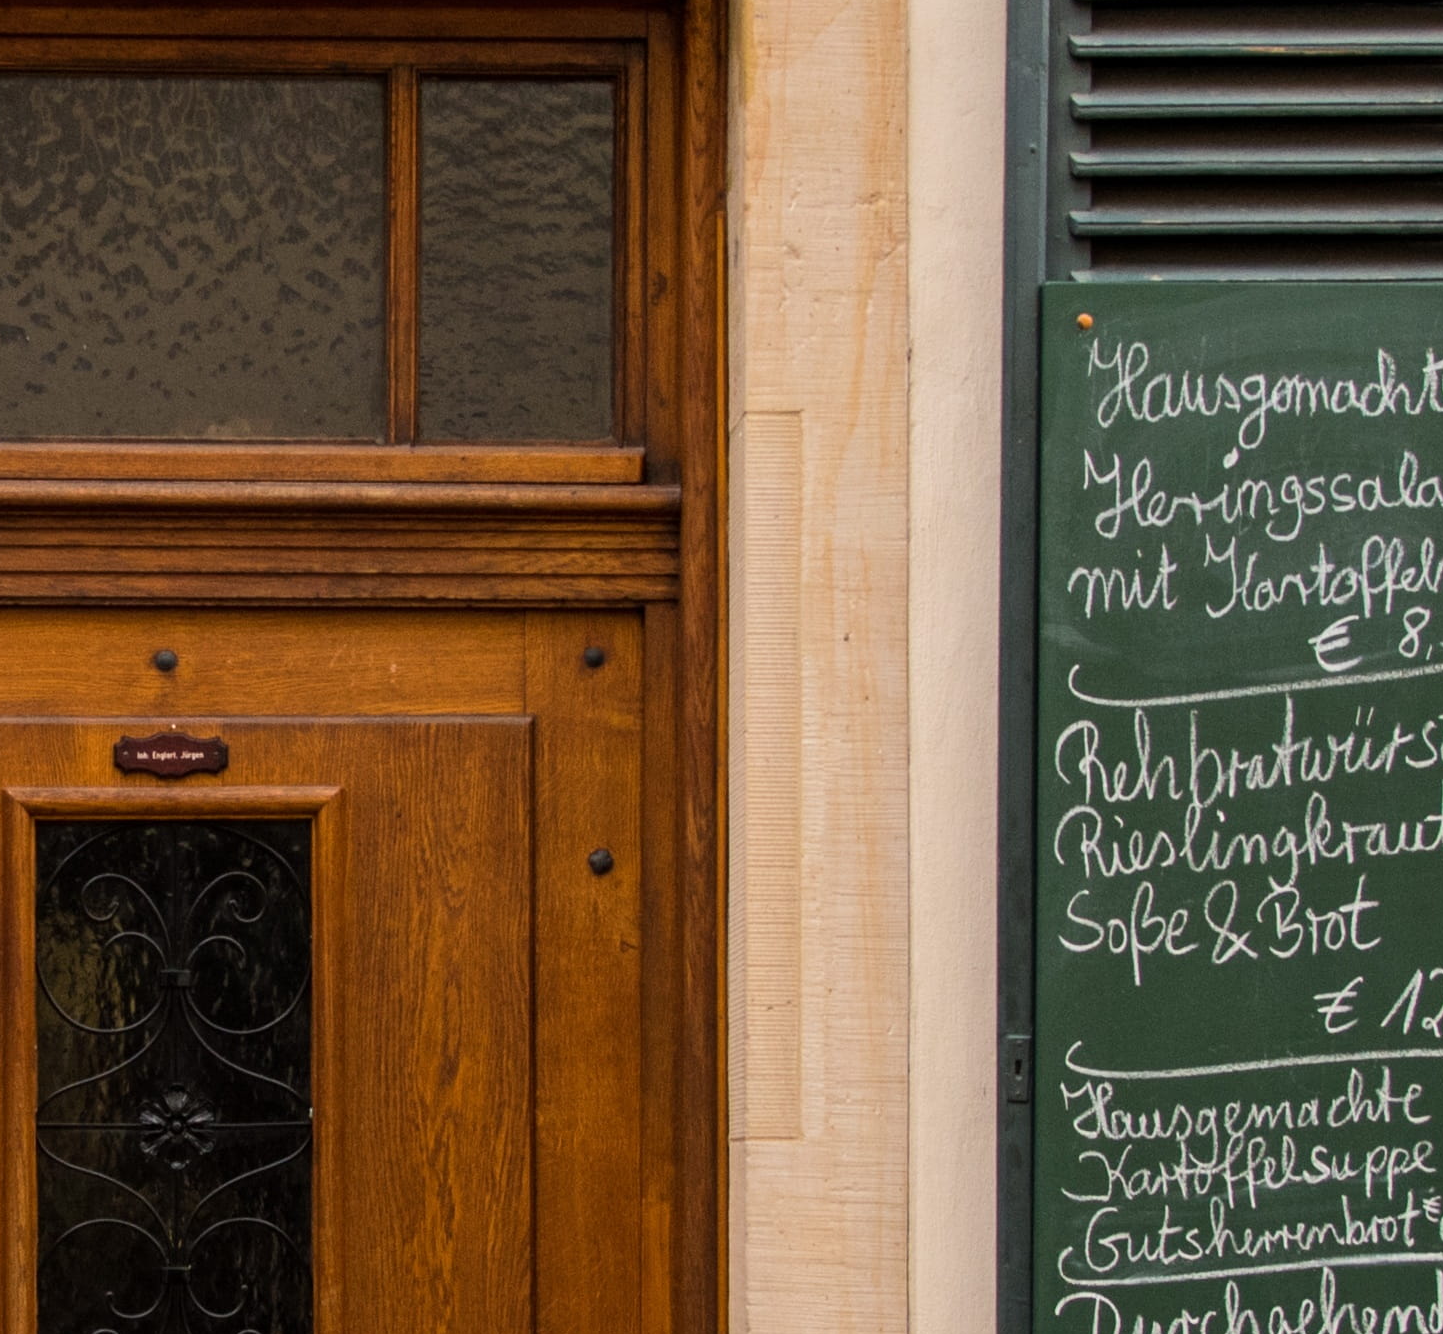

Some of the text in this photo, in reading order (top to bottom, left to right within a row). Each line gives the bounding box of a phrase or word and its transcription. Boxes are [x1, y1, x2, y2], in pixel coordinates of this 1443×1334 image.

[1067, 544, 1177, 619] mit
[1059, 874, 1382, 987] Soße & Brot
[1061, 1068, 1432, 1170] Hausgemachte
[1061, 1133, 1436, 1209] Kartoffelsuppe
[1084, 1189, 1421, 1273] Gutsherrenbrot
